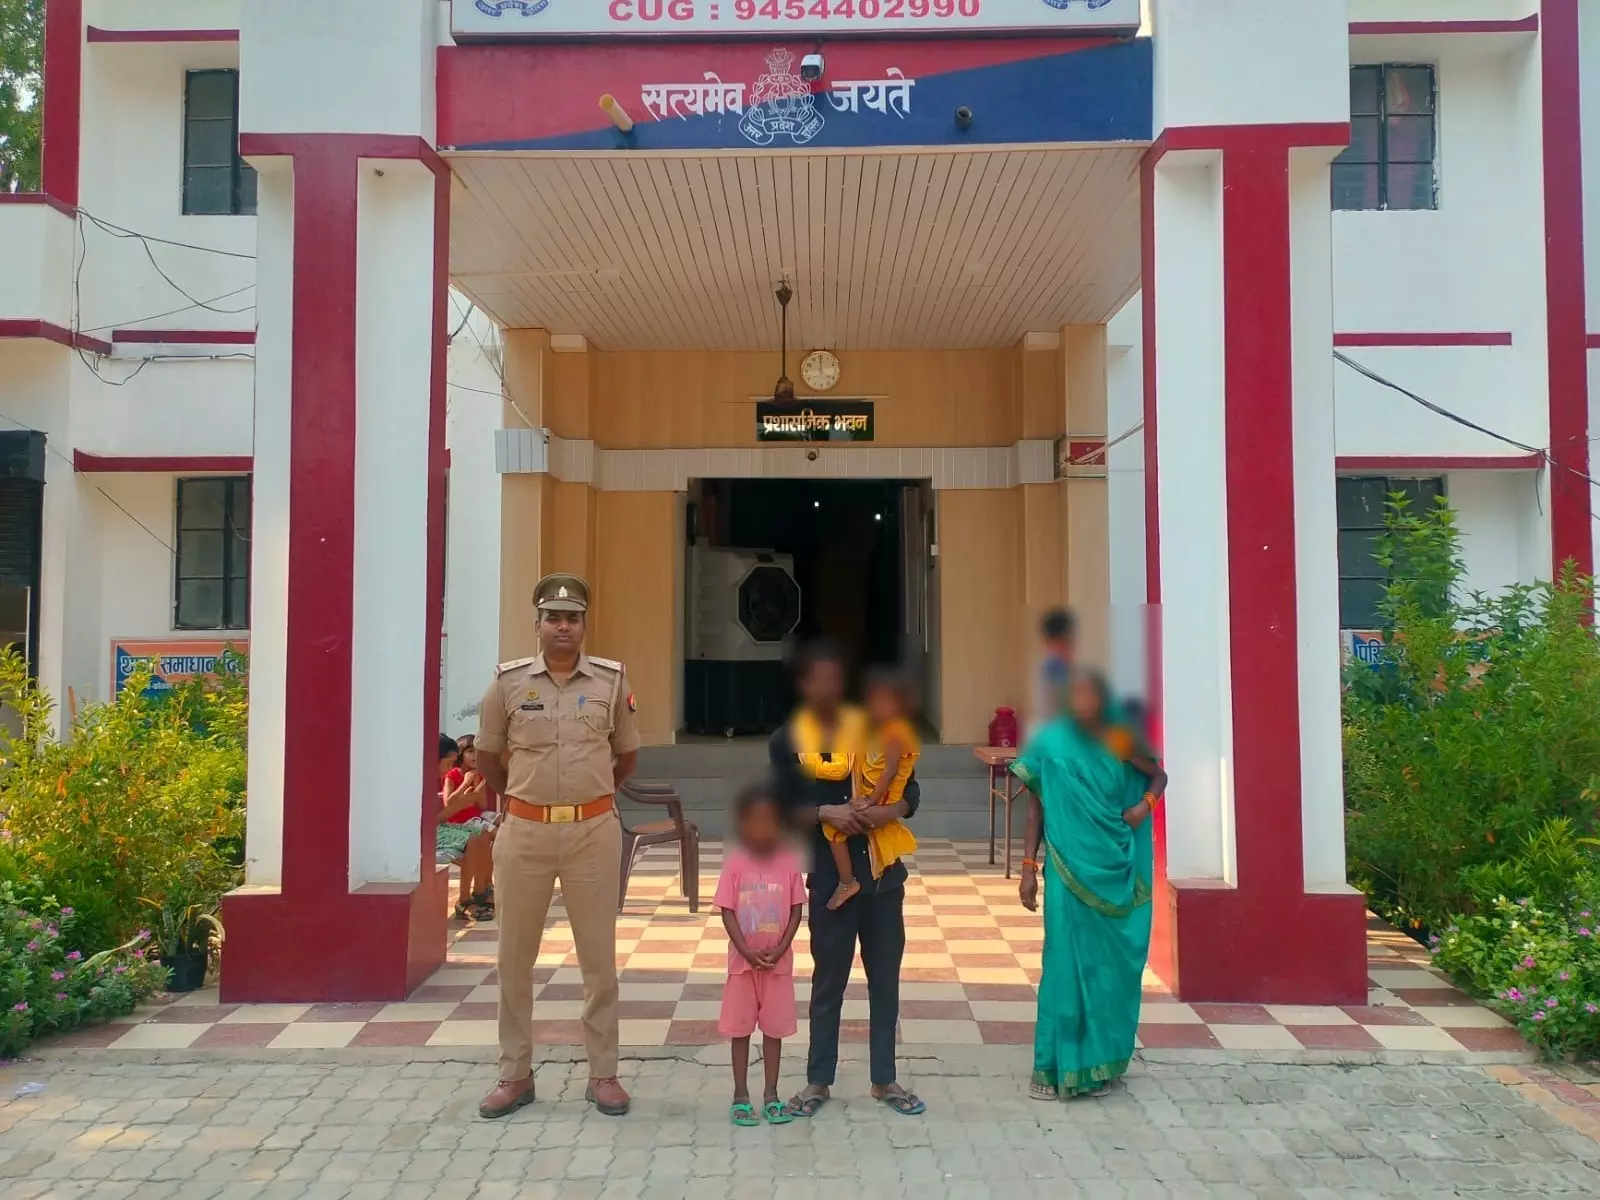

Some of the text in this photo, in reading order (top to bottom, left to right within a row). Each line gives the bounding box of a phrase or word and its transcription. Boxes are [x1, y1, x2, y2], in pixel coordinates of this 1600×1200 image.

[608, 0, 980, 21] CUG : 9454402990
[641, 67, 915, 121] सत्यमेव जयते
[763, 408, 868, 435] प्रशासनिक भवन
